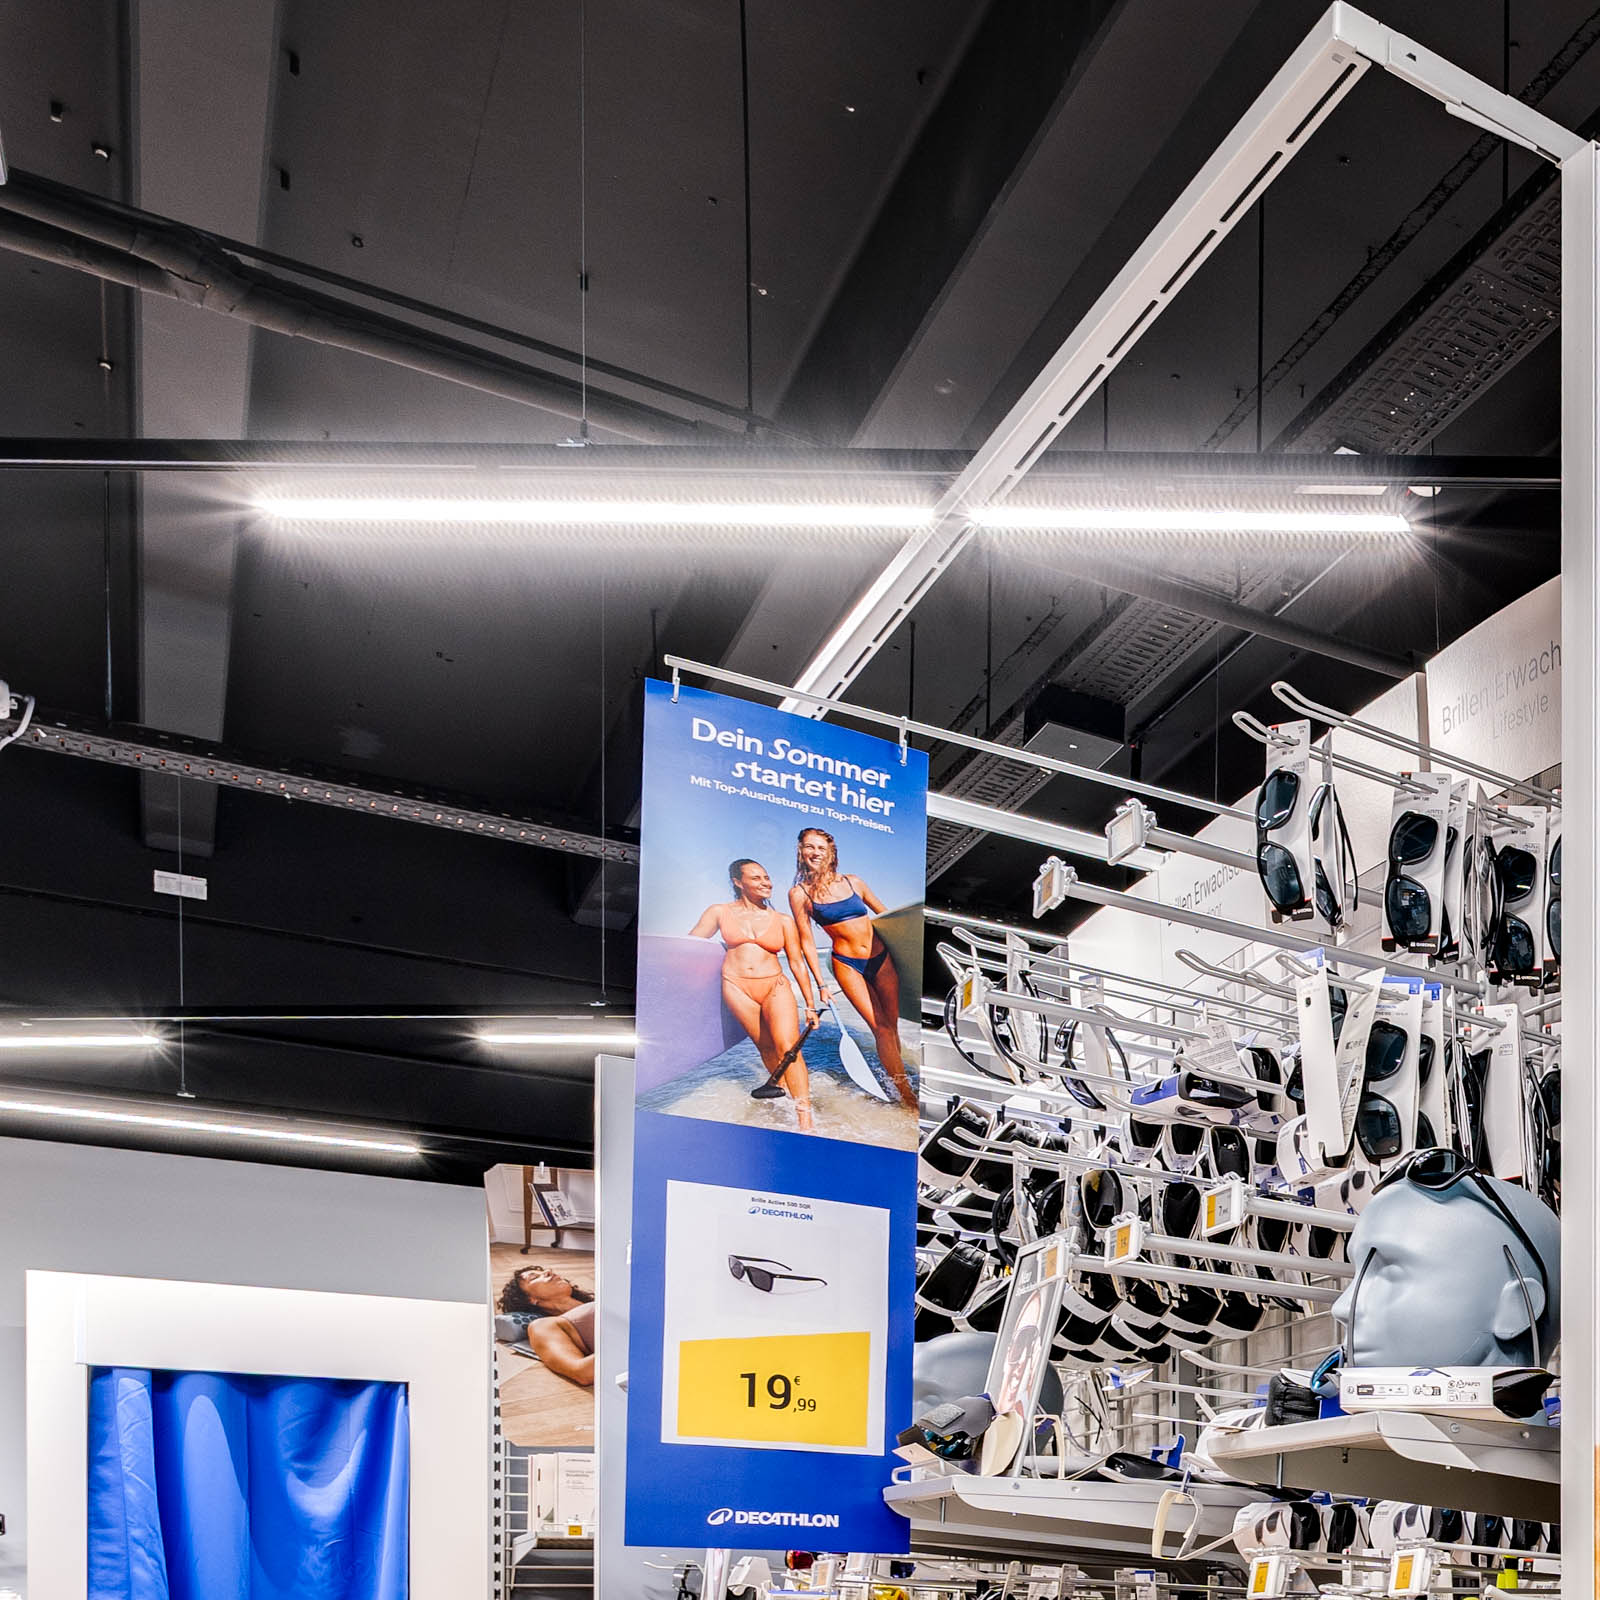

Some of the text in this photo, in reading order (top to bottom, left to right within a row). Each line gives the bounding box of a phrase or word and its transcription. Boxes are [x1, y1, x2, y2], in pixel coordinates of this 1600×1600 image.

[1442, 687, 1490, 736] Brillen
[1492, 692, 1550, 740] Lifestyle
[692, 717, 891, 788] Dein Sommer
[690, 775, 895, 834] Mit Top-Ausrüstung zu Top-Preisen.
[731, 761, 895, 817] startet hier
[762, 1208, 813, 1221] DECATHLON
[739, 1371, 792, 1409] 19
[735, 1509, 839, 1528] DECATHLON
